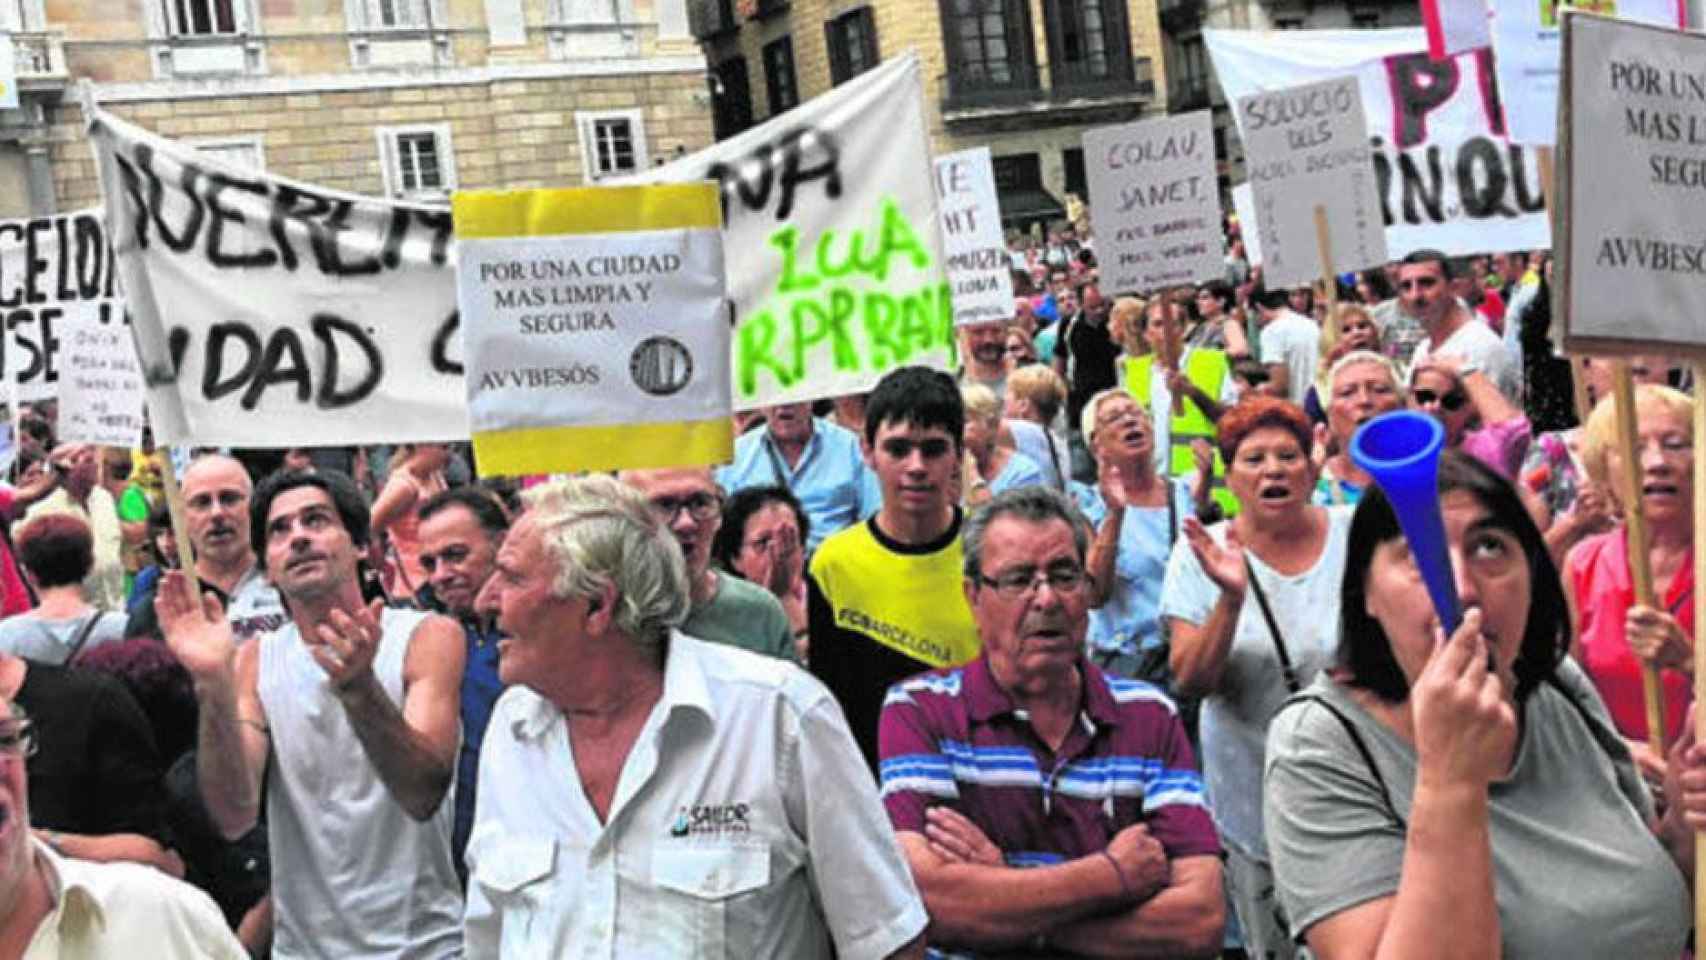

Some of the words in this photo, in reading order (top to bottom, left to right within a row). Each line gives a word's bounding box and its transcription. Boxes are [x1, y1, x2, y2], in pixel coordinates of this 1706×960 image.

[1611, 61, 1662, 97] POR
[1625, 107, 1681, 142] MAS
[479, 261, 526, 283] POR
[530, 257, 582, 280] UNA
[585, 253, 681, 277] CIUDAD
[494, 287, 546, 310] MAS
[550, 282, 632, 307] LIMPIA
[634, 280, 652, 303] Y
[520, 309, 616, 336] SEGURA
[479, 361, 601, 392] AVVBESÓS
